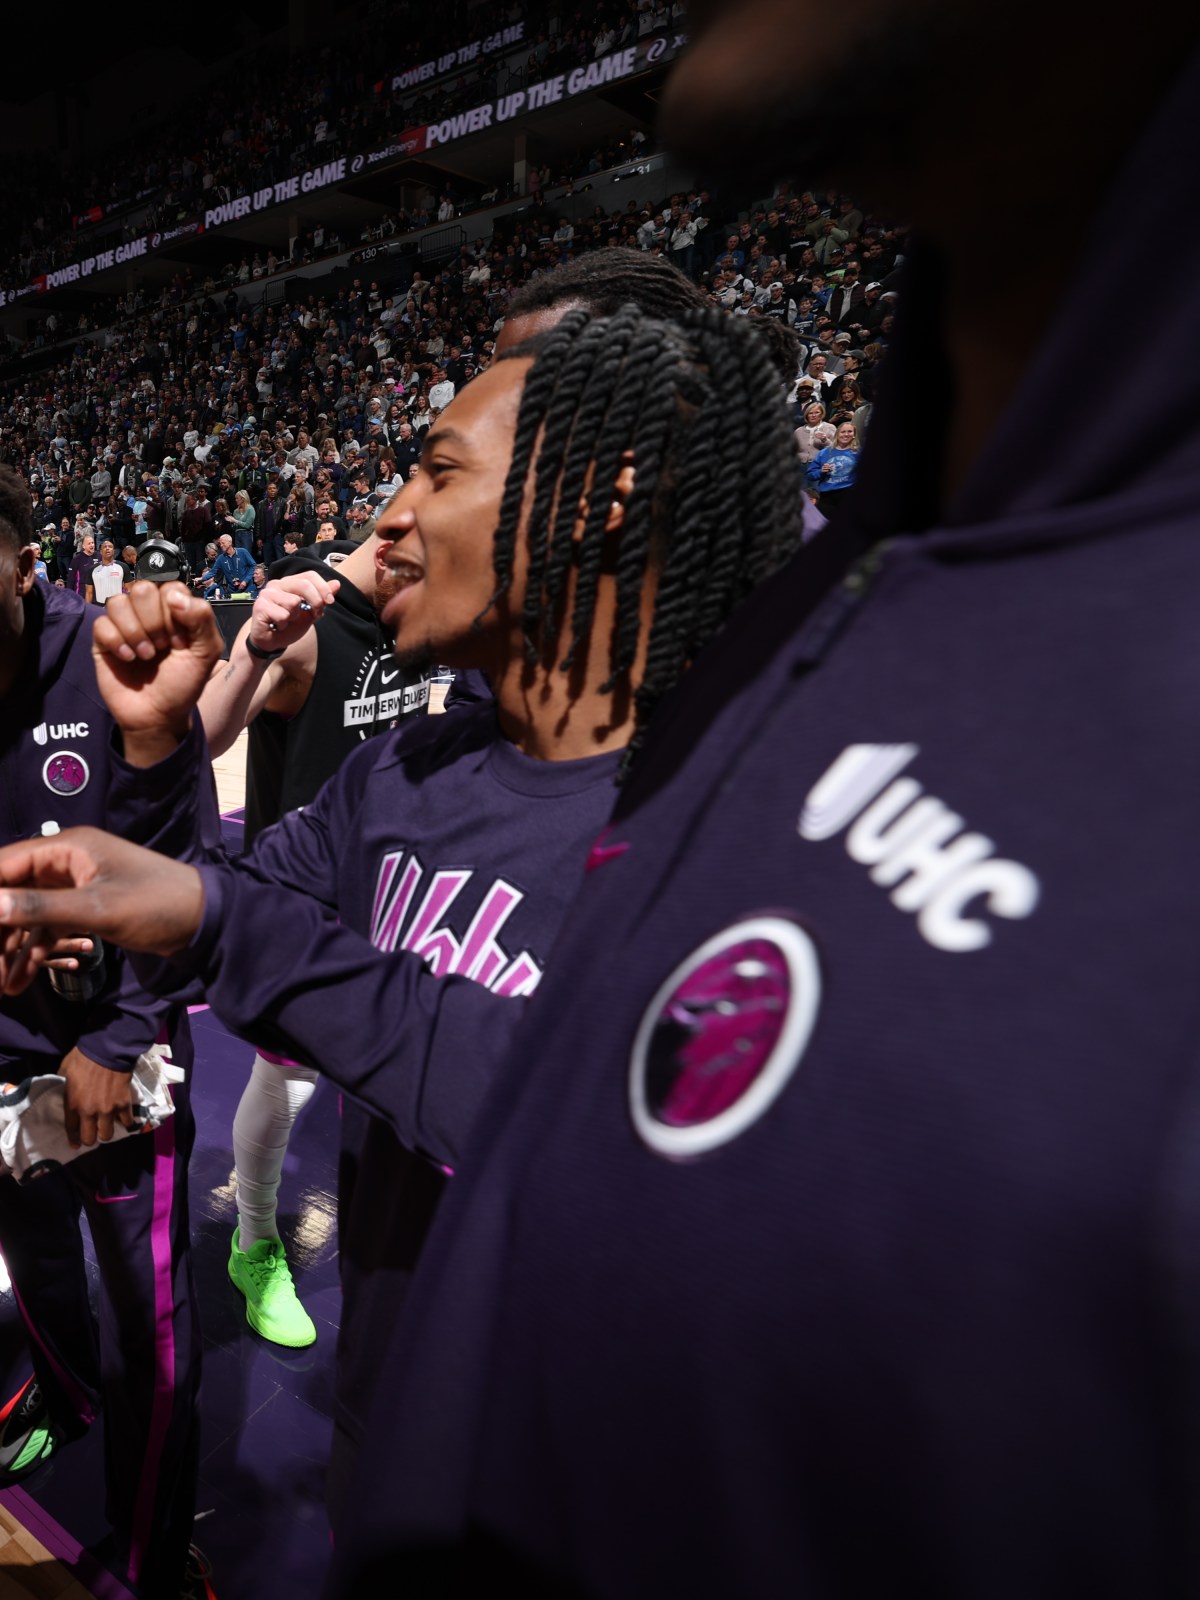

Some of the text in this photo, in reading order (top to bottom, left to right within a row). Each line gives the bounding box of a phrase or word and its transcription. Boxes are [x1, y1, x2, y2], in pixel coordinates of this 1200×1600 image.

[392, 21, 525, 91] POWER UP THE GAME
[426, 46, 638, 149] POWER UP THE GAME
[205, 157, 347, 228] POWER UP THE GAME
[46, 236, 148, 290] POWER UP THE GAME
[361, 248, 377, 260] 130
[49, 722, 89, 740] UHC
[845, 776, 1041, 952] UHC
